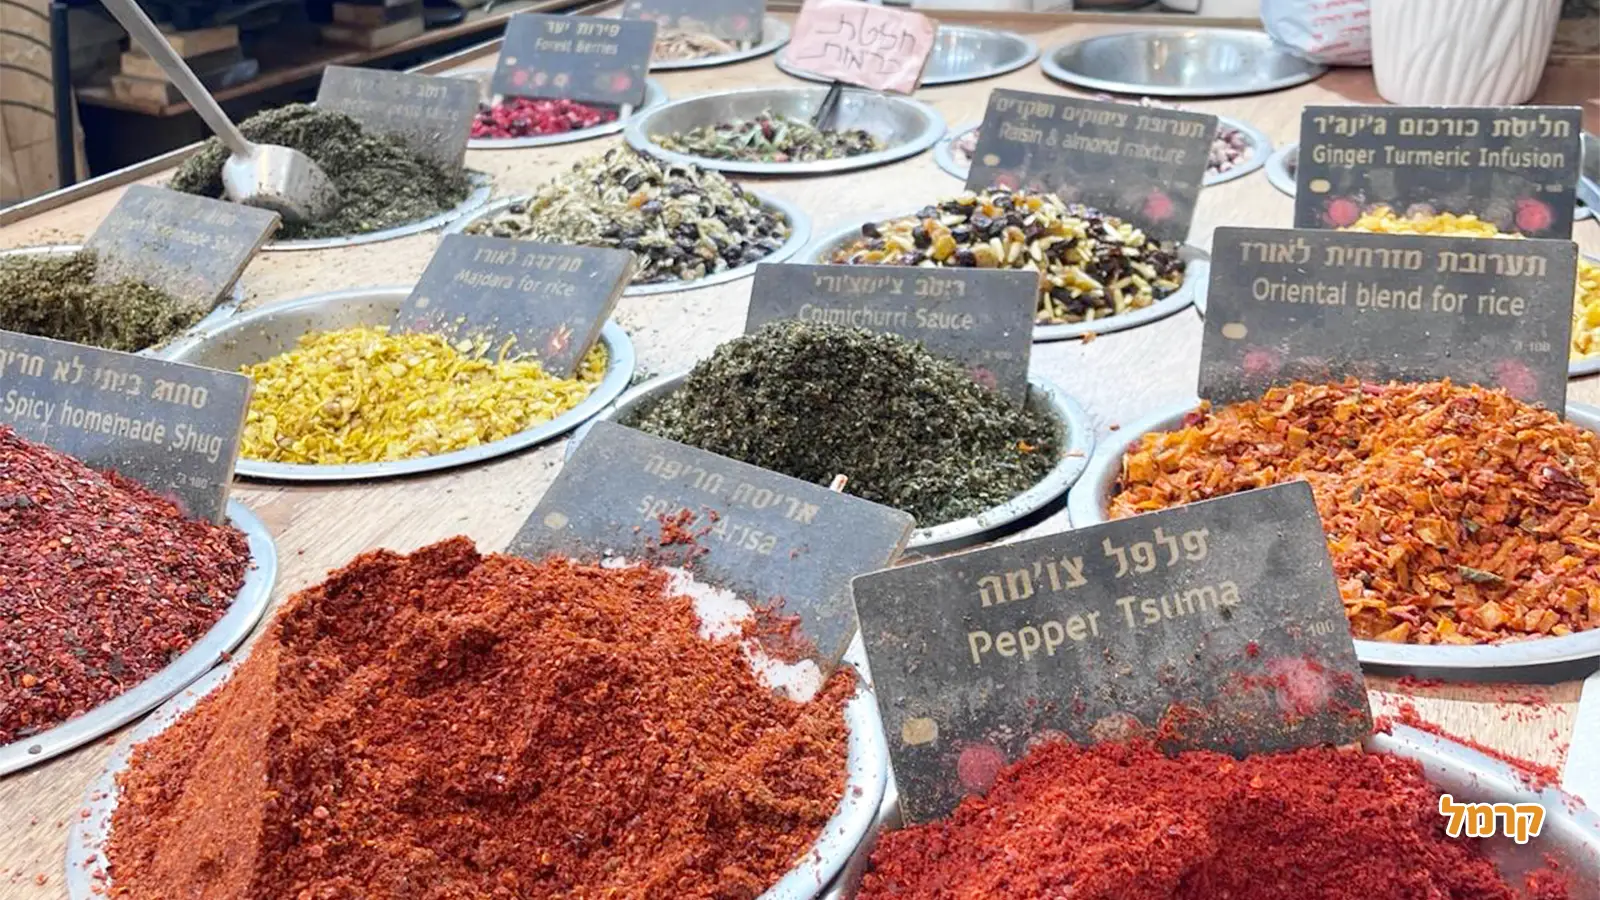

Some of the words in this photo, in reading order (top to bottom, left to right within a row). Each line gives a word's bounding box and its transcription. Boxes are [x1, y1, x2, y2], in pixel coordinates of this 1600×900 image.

[546, 21, 570, 34] יער
[576, 22, 621, 37] פירות
[535, 37, 572, 53] Forest
[576, 40, 619, 56] Berries
[996, 97, 1055, 121] ושקדים
[1135, 115, 1205, 138] תערובת
[1399, 118, 1480, 138] כורכום
[1491, 114, 1570, 138] חליטת
[998, 121, 1042, 144] Raisin
[1045, 127, 1058, 147] &
[1062, 131, 1120, 155] almond
[1123, 140, 1186, 166] mixture
[1312, 144, 1376, 169] Ginger
[1384, 145, 1471, 166] Turmeric
[1478, 147, 1565, 169] Infusion
[472, 245, 517, 266] לאורז
[1239, 238, 1311, 265] לאורז
[1324, 244, 1422, 271] מזרחית
[1437, 251, 1548, 278] תערובת
[454, 267, 515, 291] Majdara
[517, 273, 543, 292] for
[544, 278, 577, 297] rice
[1252, 275, 1347, 306] Oriental
[1356, 282, 1423, 312] blend
[1432, 285, 1469, 314] for
[1477, 288, 1525, 317] rice
[916, 306, 974, 331] Sauce
[52, 354, 86, 385] לא
[92, 367, 145, 396] ביתי
[60, 399, 165, 445] homemade
[172, 421, 224, 464] Shug
[643, 453, 725, 496] חריפה
[730, 482, 821, 525] אריסה
[712, 514, 778, 556] Arisa
[1101, 527, 1211, 579] פלפל
[968, 609, 1101, 665] Pepper
[1116, 579, 1242, 629] Tsuma
[1305, 618, 1336, 637] 100
